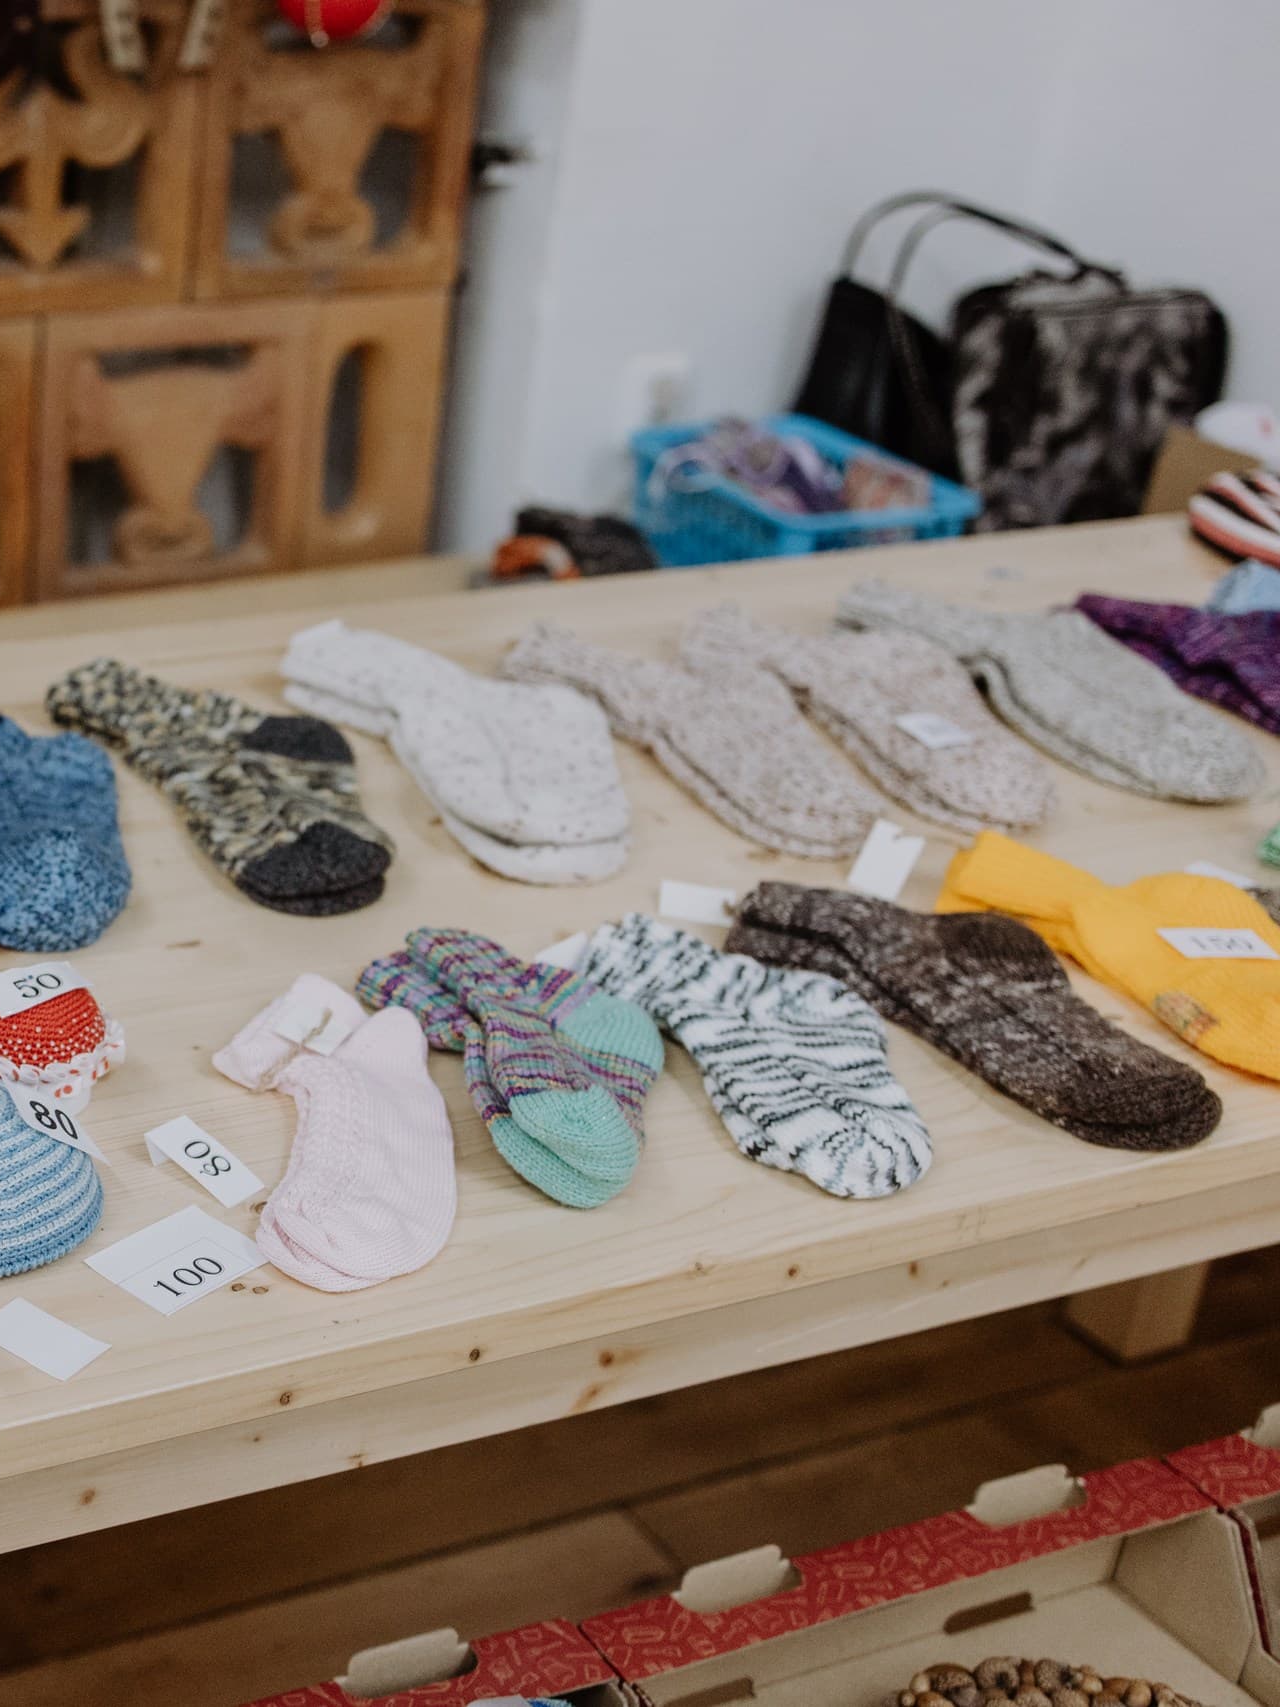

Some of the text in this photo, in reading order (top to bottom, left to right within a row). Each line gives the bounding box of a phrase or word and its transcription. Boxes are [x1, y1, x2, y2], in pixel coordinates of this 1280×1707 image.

[13, 973, 61, 998] 50
[29, 1100, 78, 1140] 80
[184, 1141, 231, 1176] 80
[153, 1257, 223, 1296] 100
